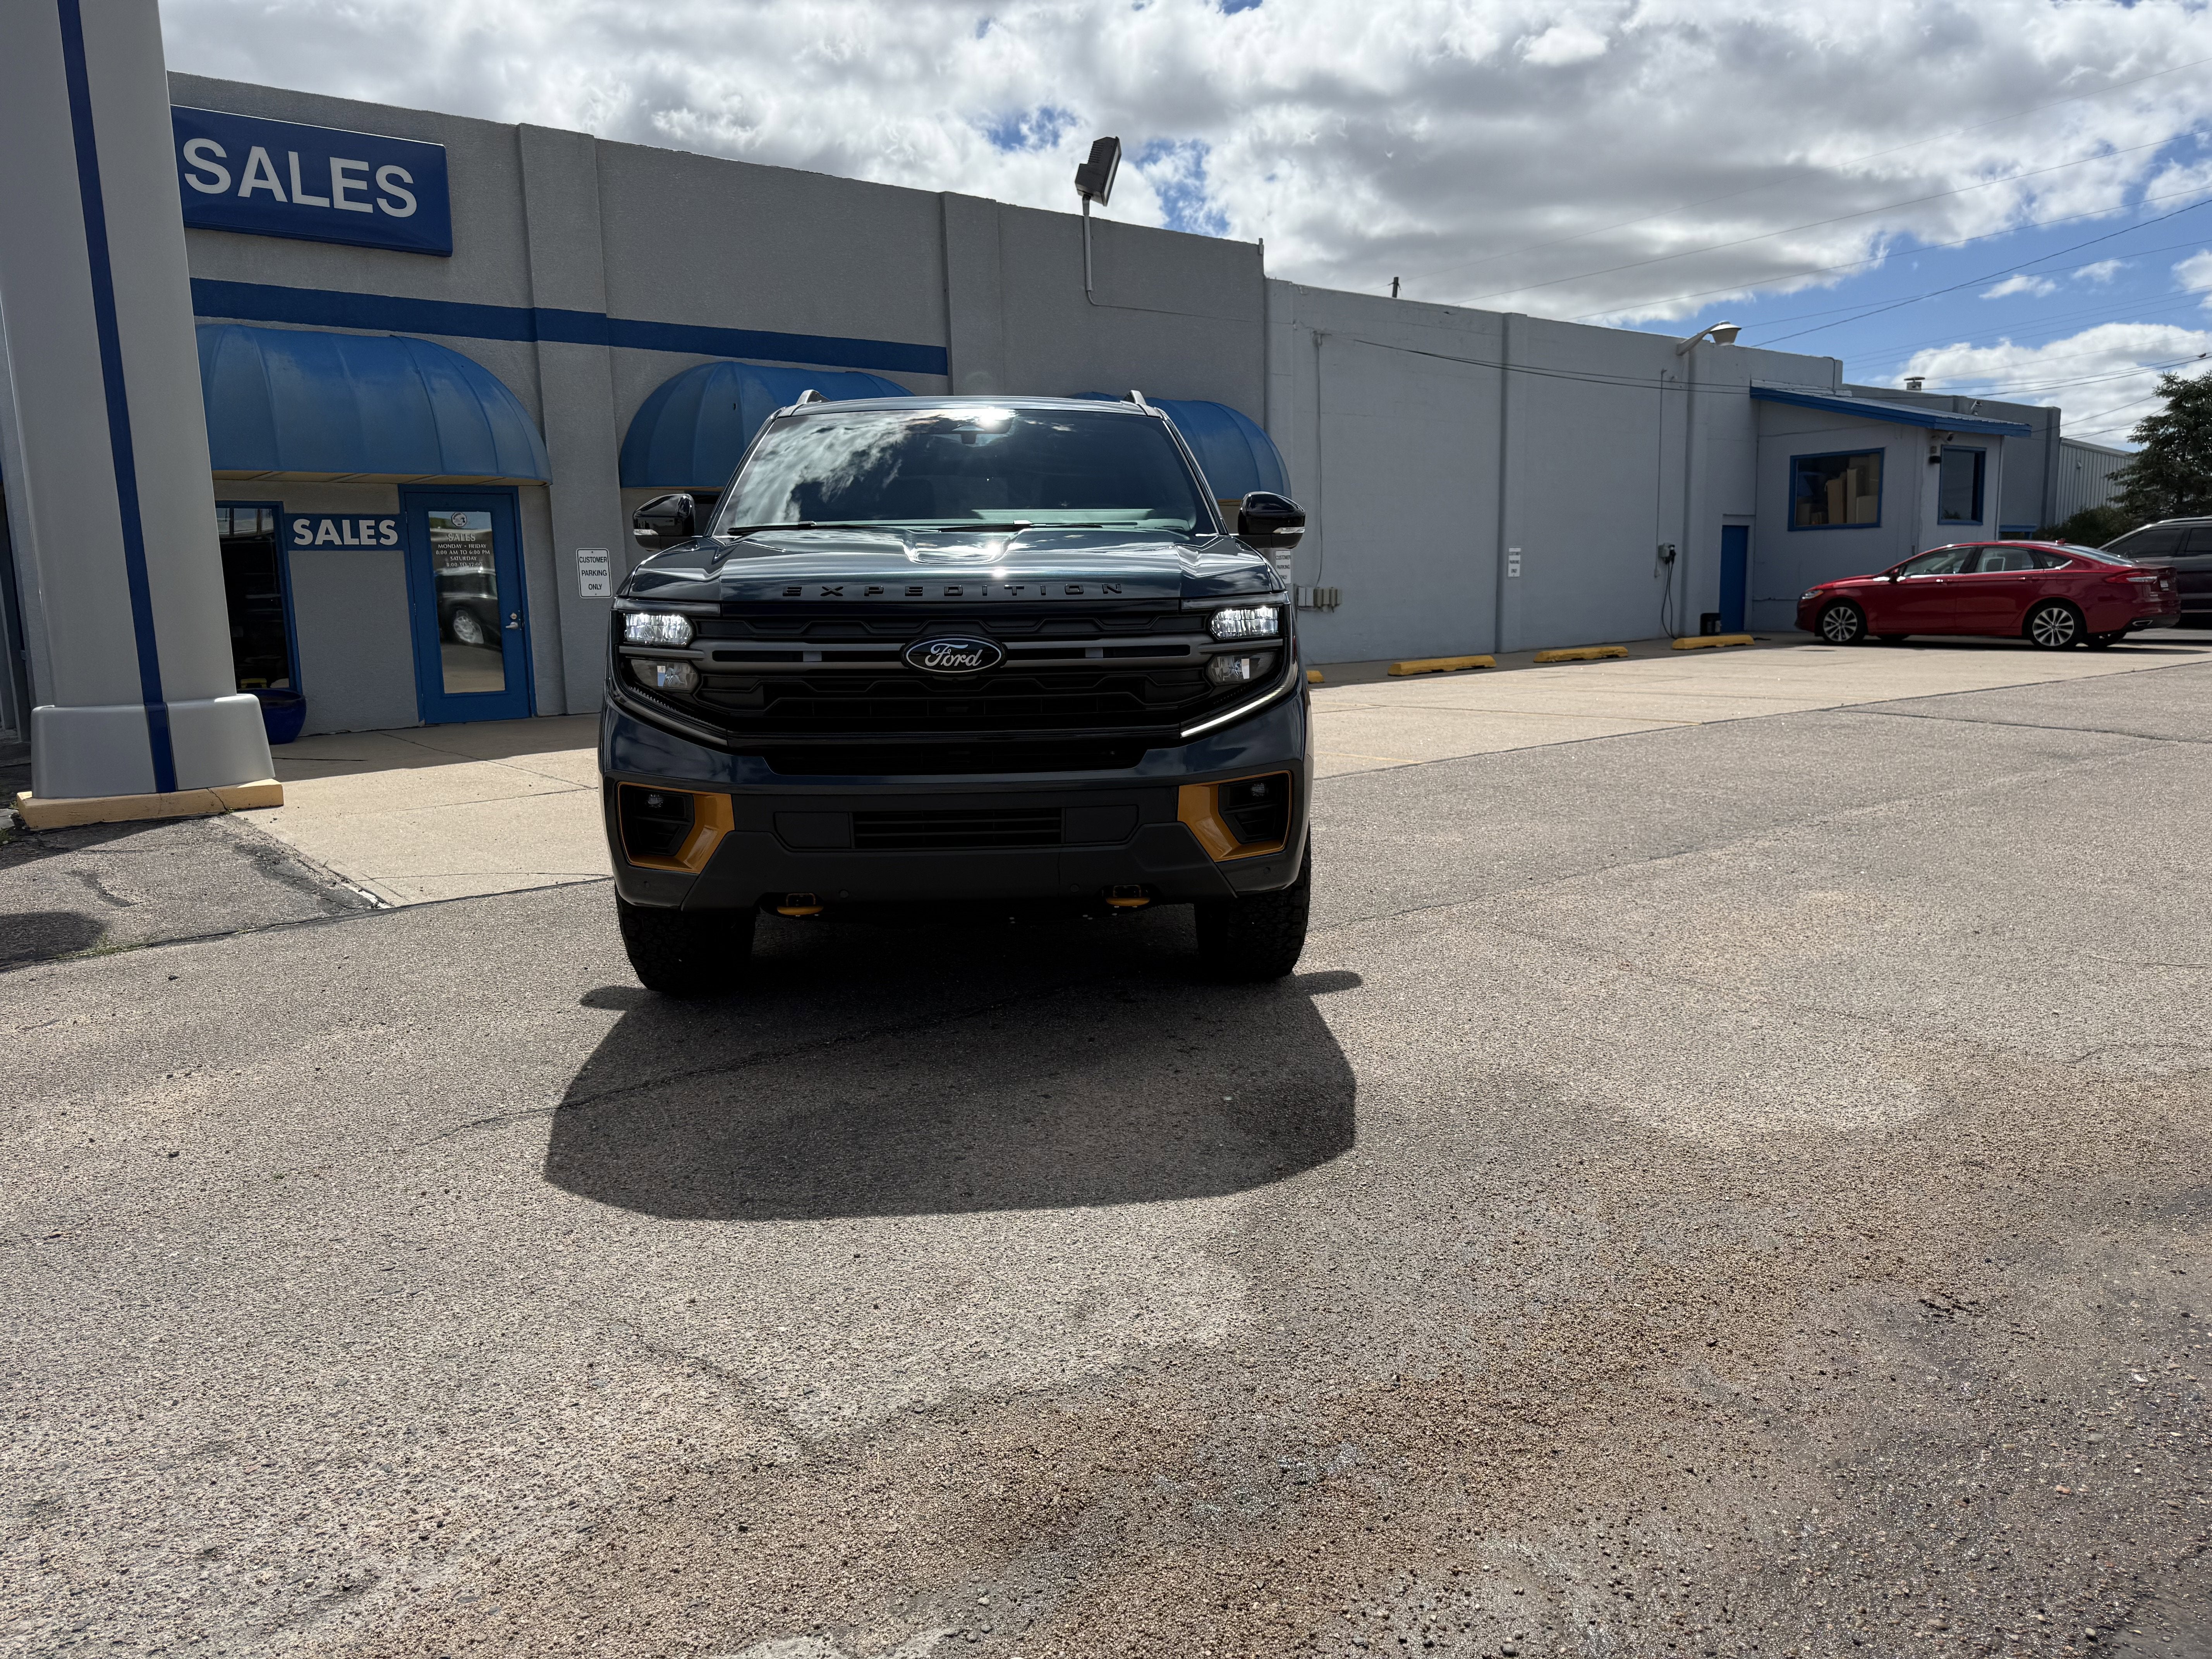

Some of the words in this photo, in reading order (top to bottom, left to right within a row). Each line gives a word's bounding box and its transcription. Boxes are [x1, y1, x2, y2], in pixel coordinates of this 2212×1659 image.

[183, 138, 417, 218] SALES
[293, 519, 398, 545] SALES
[447, 533, 476, 541] SALES
[782, 583, 1122, 596] EXPEDITION
[925, 643, 982, 666] Ford
